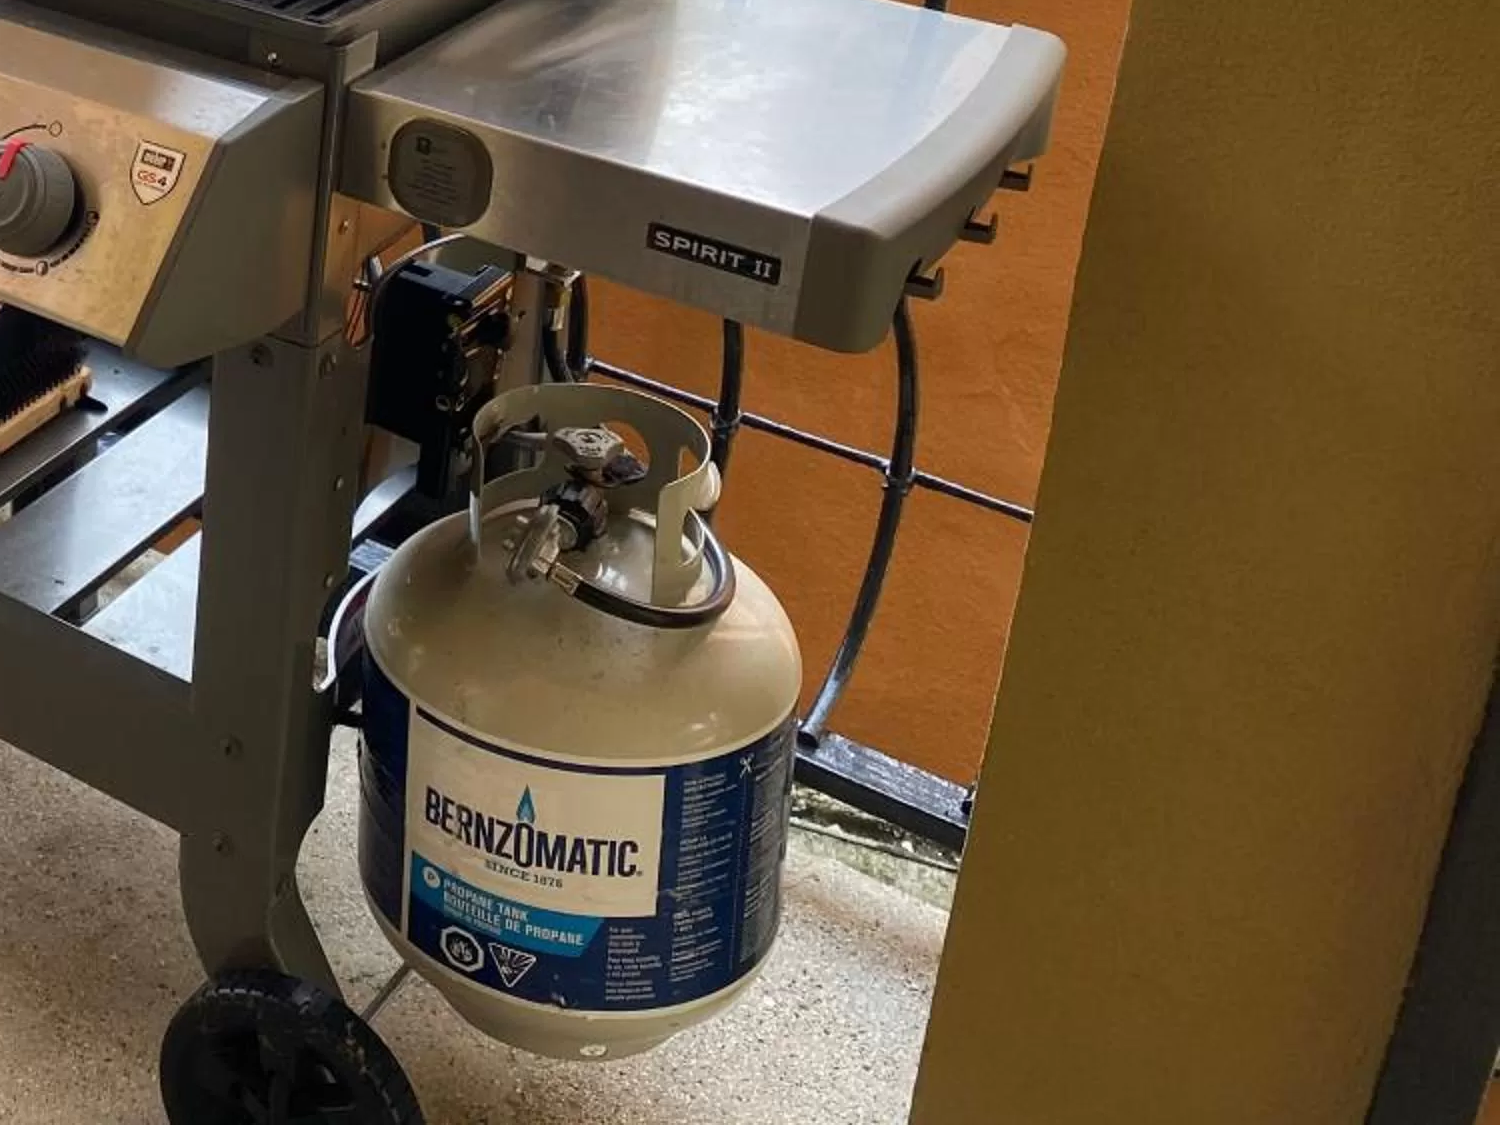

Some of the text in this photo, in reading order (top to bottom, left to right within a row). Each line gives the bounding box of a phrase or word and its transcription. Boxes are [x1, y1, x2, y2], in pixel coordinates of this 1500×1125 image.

[655, 230, 772, 278] SPIRIT II
[425, 784, 639, 878] BERNZOMATIC
[484, 858, 530, 882] SINCE
[443, 878, 493, 911] PROPANE
[496, 902, 529, 922] TANK
[443, 890, 500, 924] BOUTEILLE
[505, 919, 522, 935] DE
[525, 924, 585, 946] PROPANE
